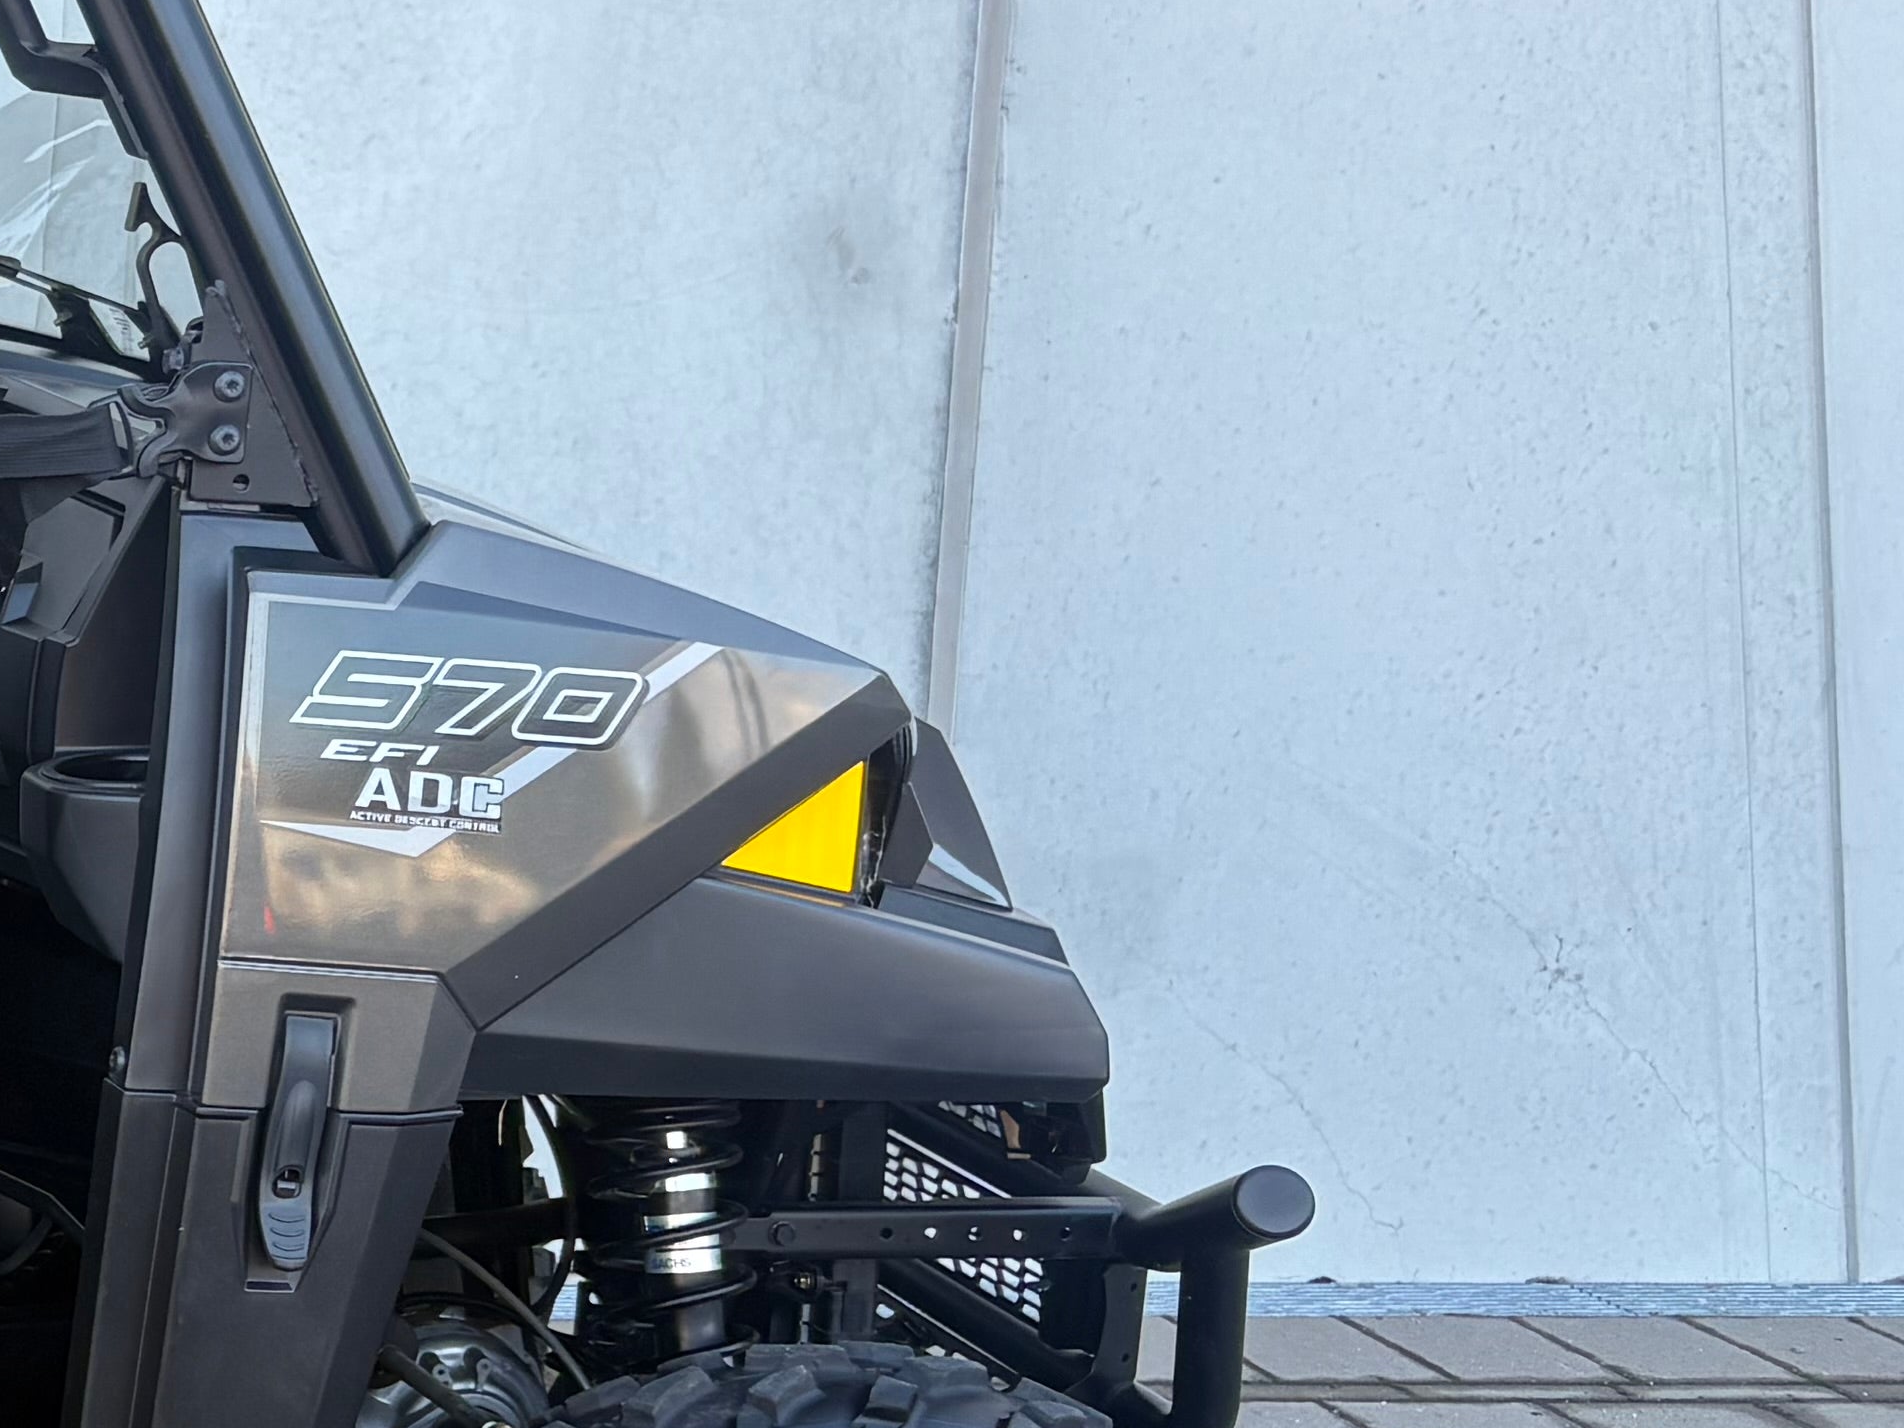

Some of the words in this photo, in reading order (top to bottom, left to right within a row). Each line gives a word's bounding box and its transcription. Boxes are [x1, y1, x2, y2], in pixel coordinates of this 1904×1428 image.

[289, 650, 645, 746] 570
[319, 738, 440, 765] EFI
[354, 767, 504, 820] ADC
[349, 810, 392, 823] ACTIVE
[394, 814, 446, 828] DESCENT
[448, 818, 502, 833] CONTROL
